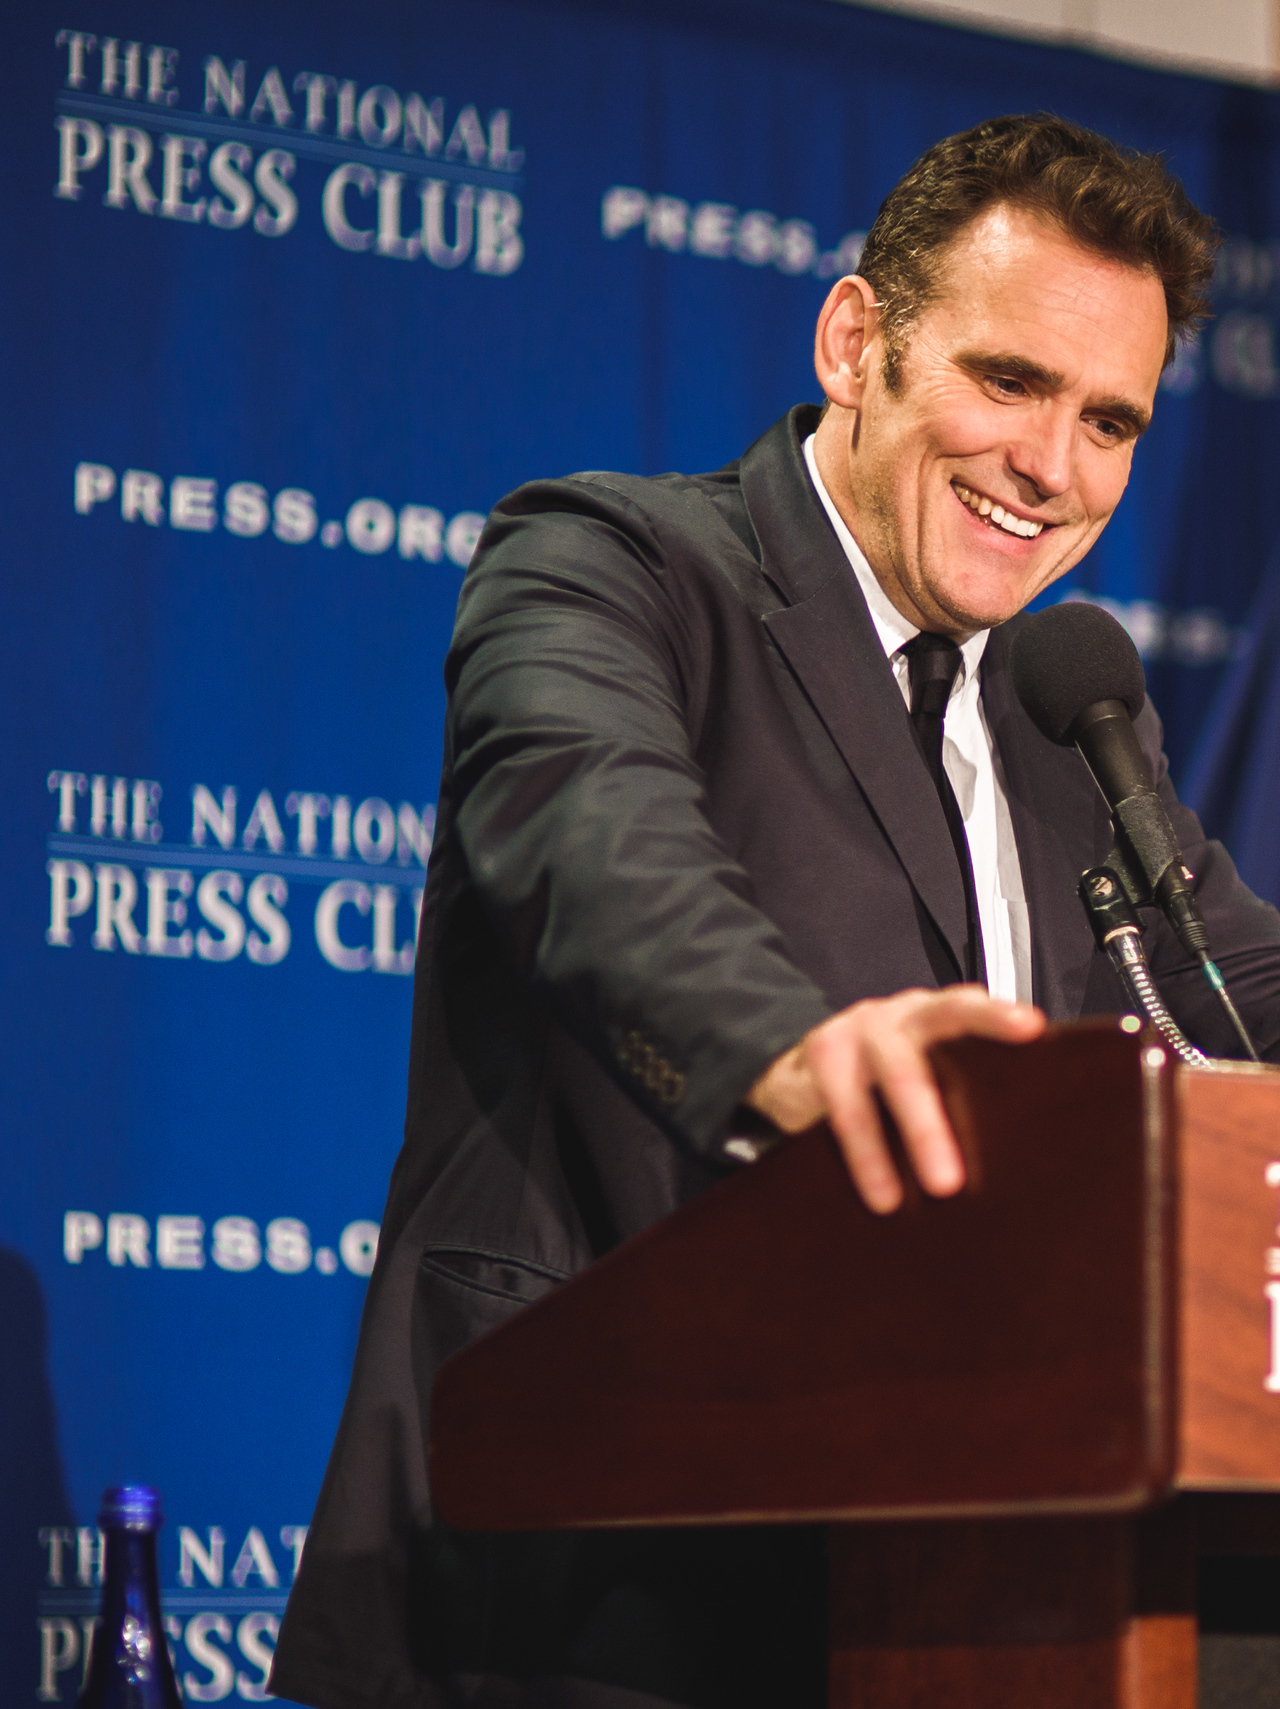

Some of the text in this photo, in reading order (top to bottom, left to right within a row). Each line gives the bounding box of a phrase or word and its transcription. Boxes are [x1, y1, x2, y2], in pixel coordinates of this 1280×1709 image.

[56, 29, 525, 170] THE NATIONAL
[54, 114, 525, 278] PRESS CLUB
[47, 769, 162, 844] THE
[47, 858, 425, 976] PRESS CL
[37, 1525, 107, 1588] TH
